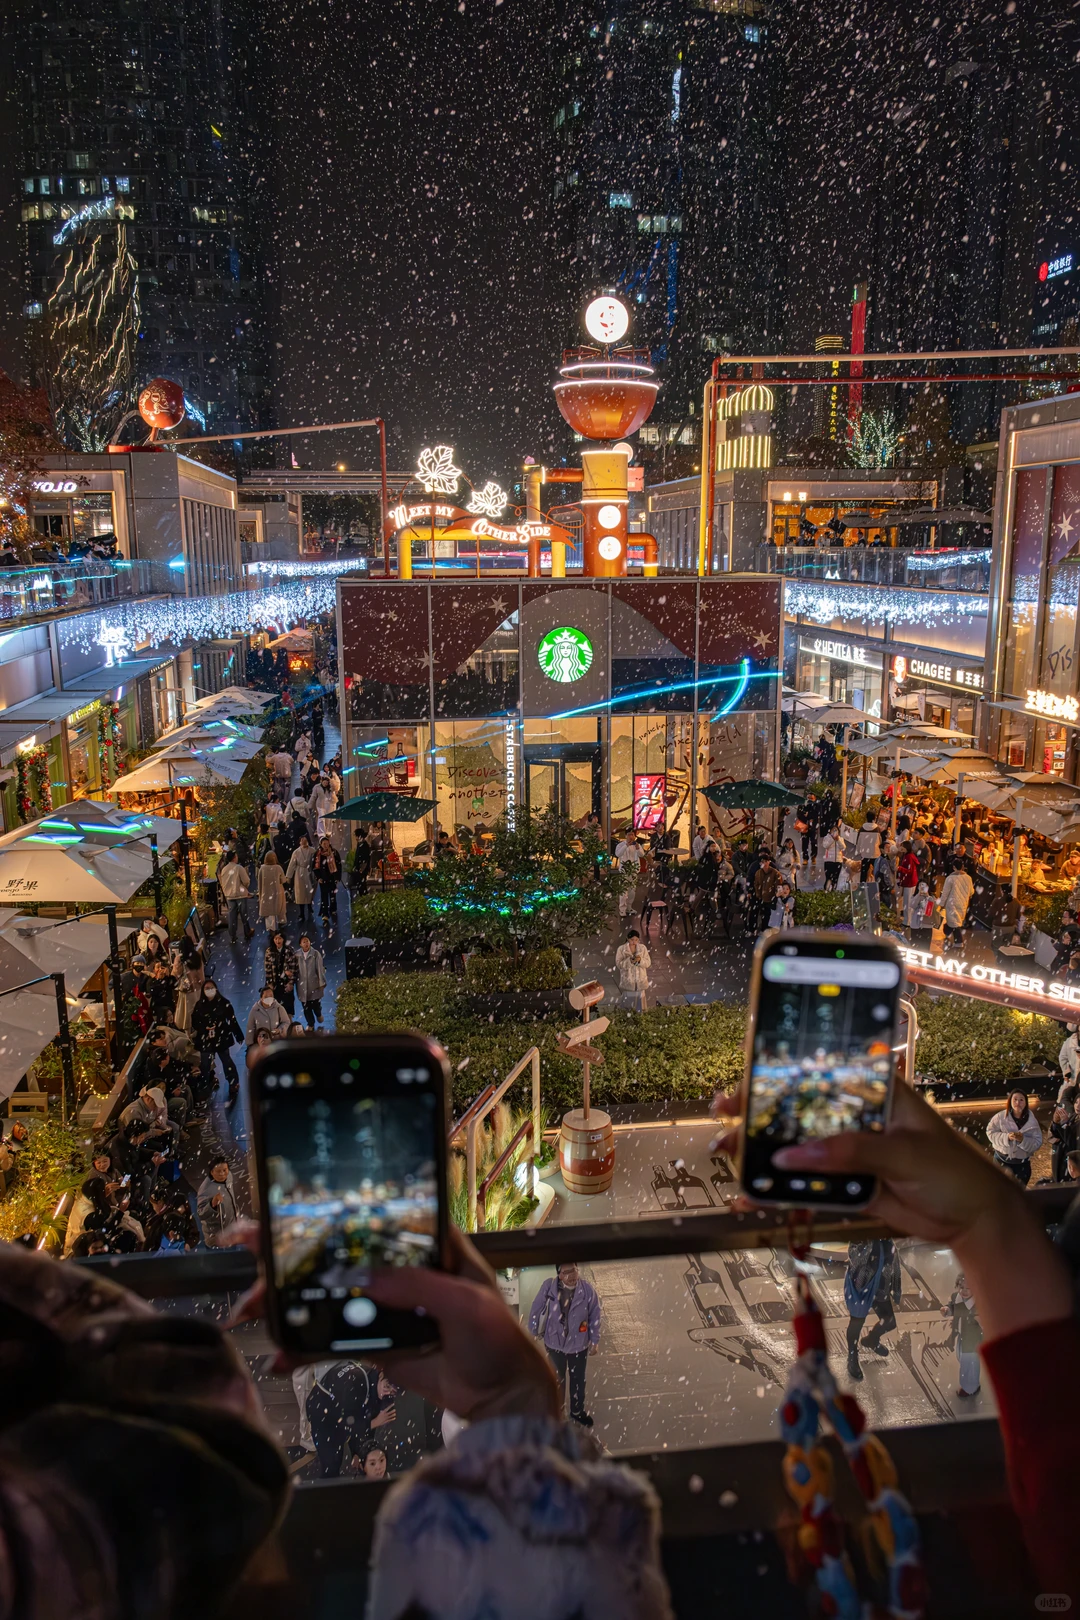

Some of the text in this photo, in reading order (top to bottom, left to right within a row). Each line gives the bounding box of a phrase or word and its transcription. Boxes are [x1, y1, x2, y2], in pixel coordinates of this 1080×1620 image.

[388, 504, 454, 528] MEET MY
[471, 518, 551, 544] OTHER SIDE
[823, 640, 852, 660] HEYTEA
[911, 659, 984, 688] CHAGEE 霸王茶
[506, 724, 515, 793] STARBUCKS
[467, 811, 492, 820] me
[5, 878, 38, 890] 野果
[935, 955, 968, 976] MY
[970, 964, 1045, 995] OTHER
[1048, 981, 1080, 1004] SID
